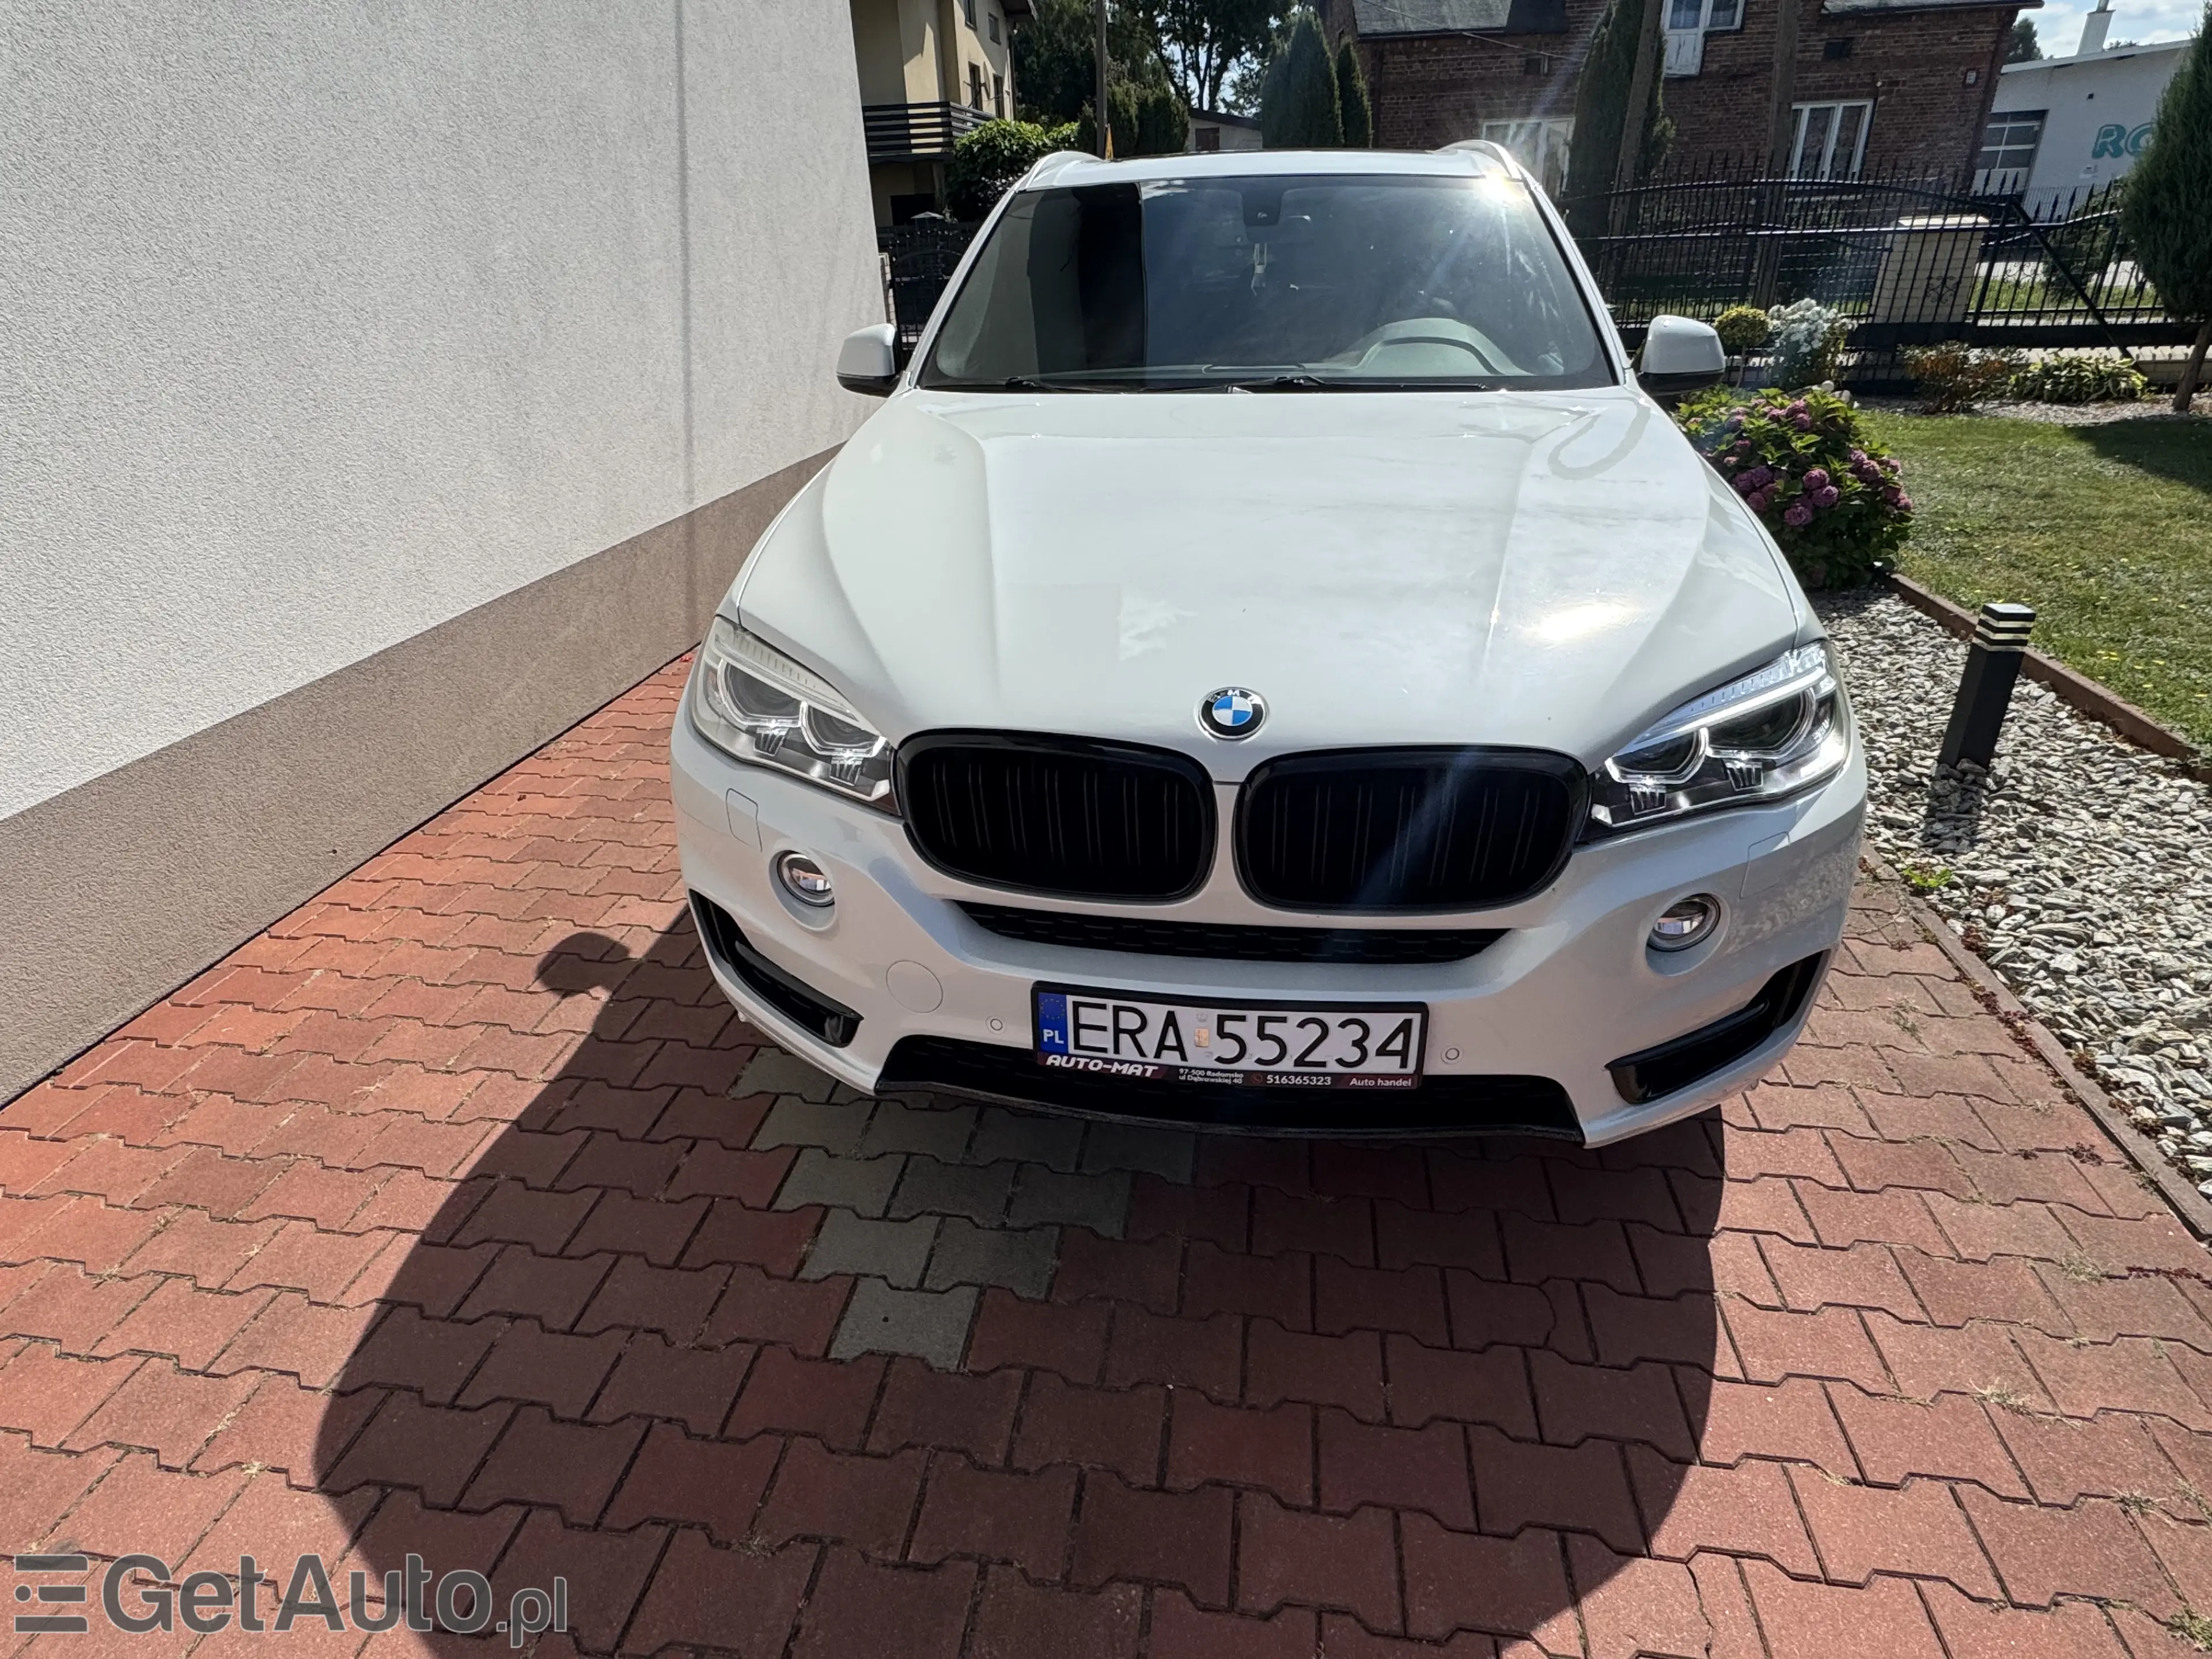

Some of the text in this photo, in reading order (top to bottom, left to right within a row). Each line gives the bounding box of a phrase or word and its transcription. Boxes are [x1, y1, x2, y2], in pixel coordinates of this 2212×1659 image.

[1043, 1029, 1065, 1044] PL
[1072, 1001, 1413, 1069] ERA 55234
[1046, 1054, 1158, 1077] AUTO-MAT
[1266, 1074, 1331, 1085] 516365323
[1350, 1077, 1411, 1086] Auto handel
